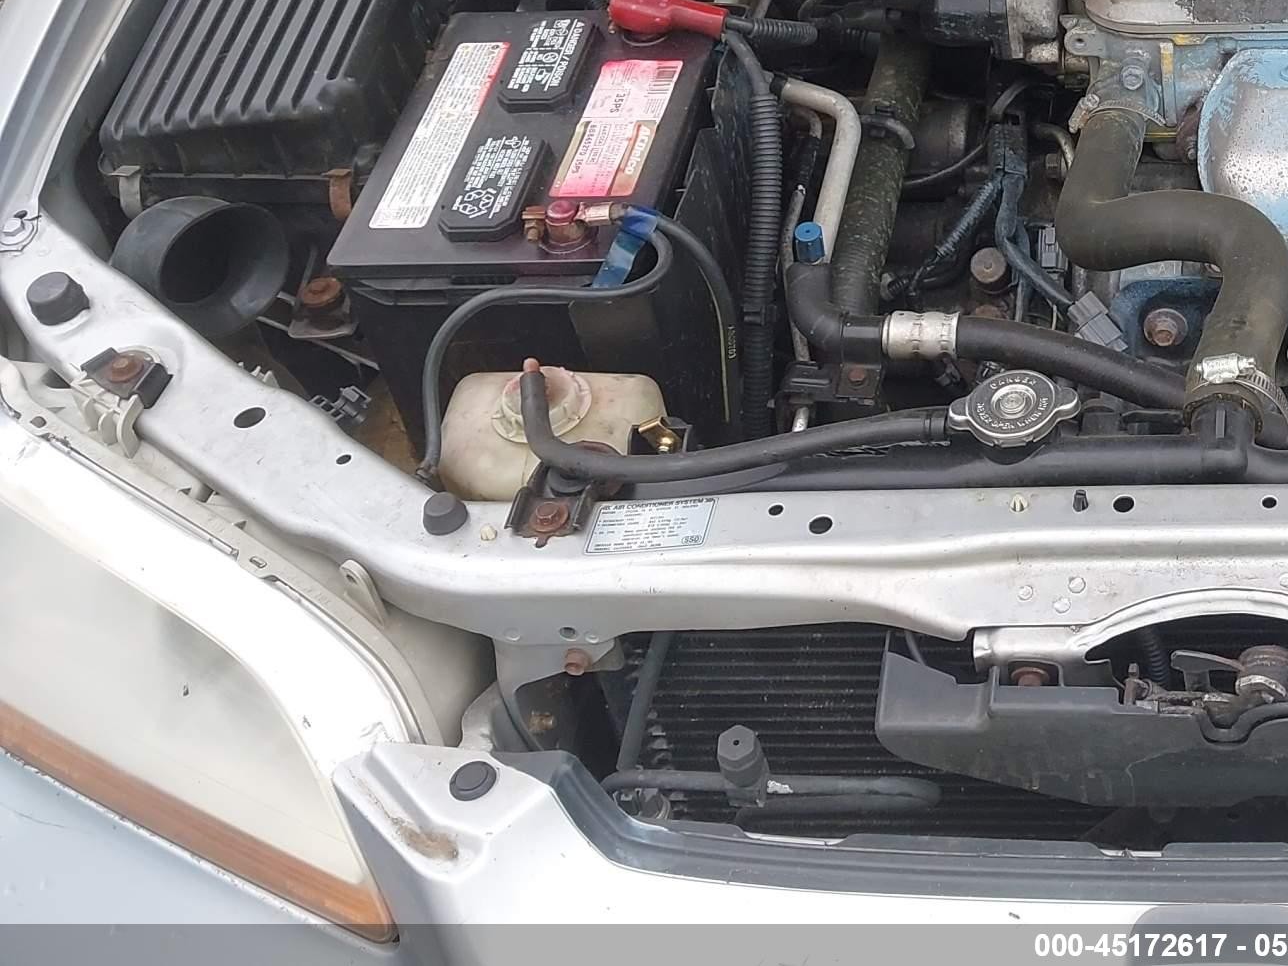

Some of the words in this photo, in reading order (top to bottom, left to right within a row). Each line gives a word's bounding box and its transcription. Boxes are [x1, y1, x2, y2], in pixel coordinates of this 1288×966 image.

[609, 93, 626, 113] 35PS
[623, 125, 651, 175] ACDelco
[626, 501, 675, 509] CONDITIONER
[675, 497, 704, 506] SYSTEM
